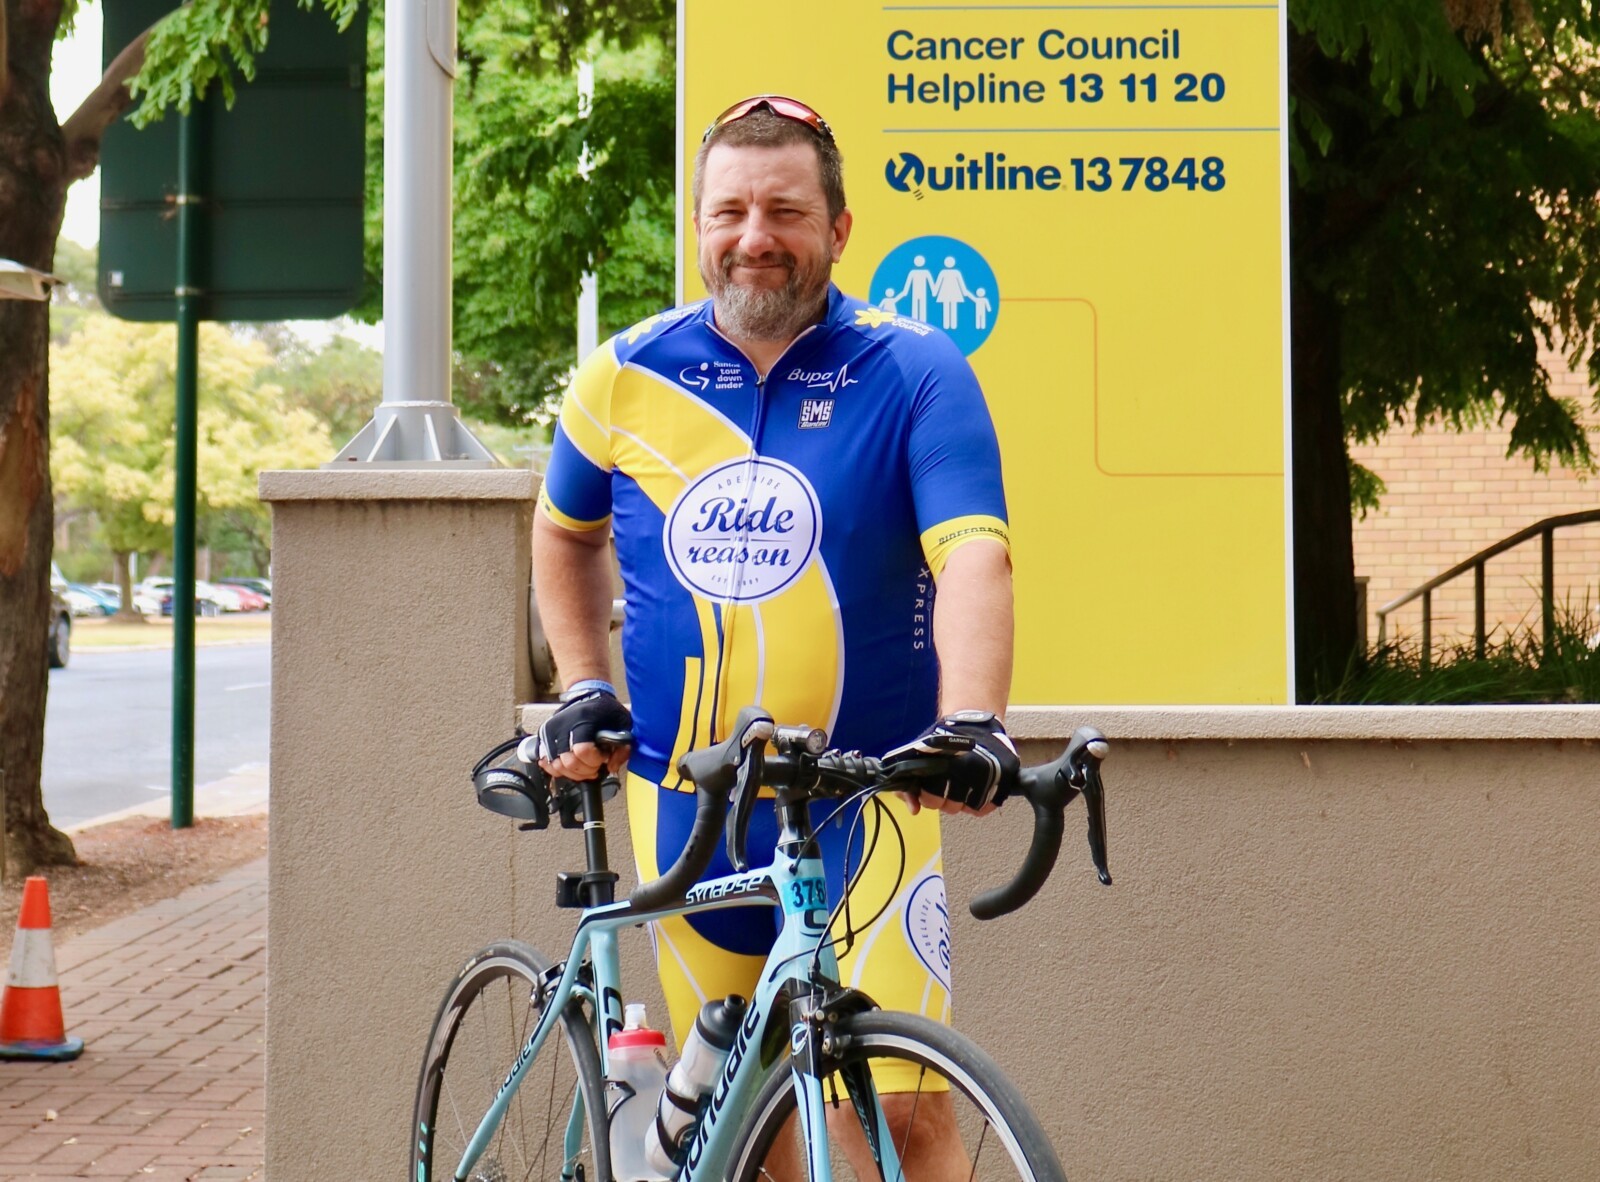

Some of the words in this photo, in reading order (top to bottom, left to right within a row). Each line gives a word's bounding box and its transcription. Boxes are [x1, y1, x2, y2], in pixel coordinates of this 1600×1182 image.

[886, 29, 1024, 60] Cancer
[1037, 28, 1180, 60] Council
[887, 72, 1046, 111] Helpline
[1059, 72, 1104, 103] 13
[1119, 72, 1157, 103] 11
[1174, 72, 1226, 103] 20
[885, 151, 1061, 194] Quitline
[715, 382, 744, 390] under
[716, 374, 743, 383] down
[787, 368, 834, 385] Bupa
[801, 400, 833, 422] SMS
[717, 475, 781, 490] ADEAIDE
[692, 496, 795, 534] Ride
[687, 545, 791, 567] reason
[913, 559, 931, 650] XPRESS
[790, 879, 827, 908] 376
